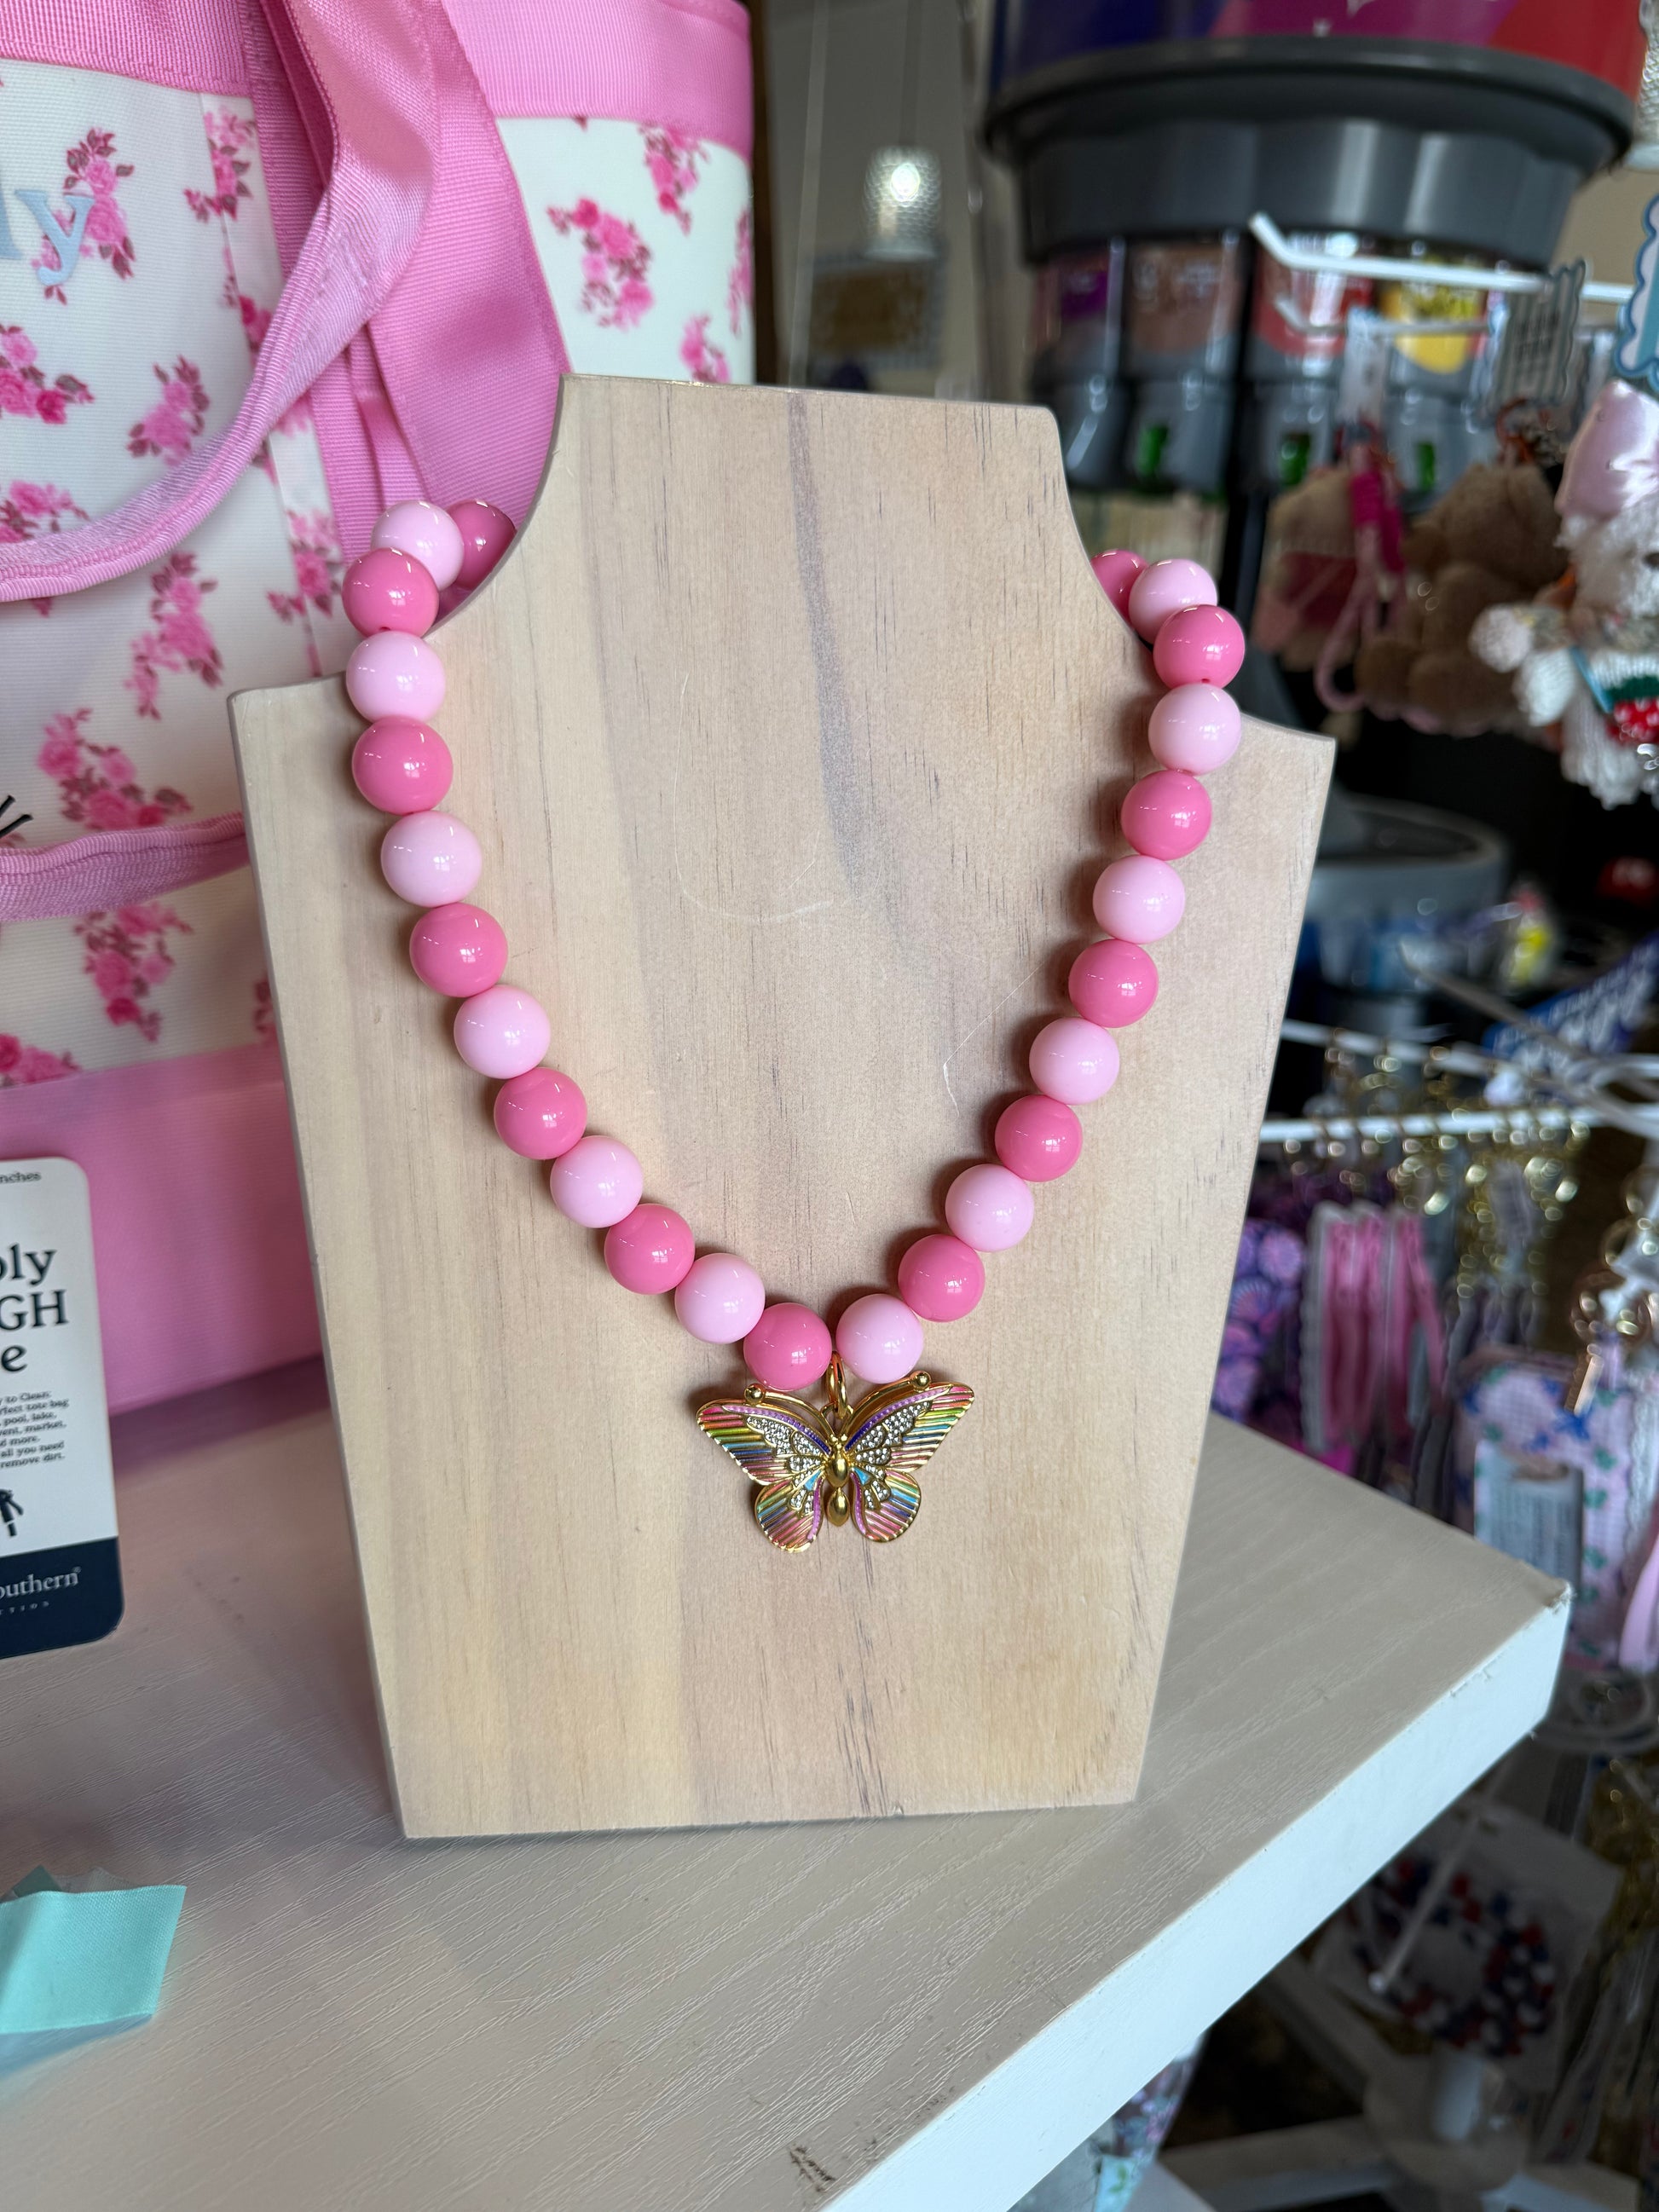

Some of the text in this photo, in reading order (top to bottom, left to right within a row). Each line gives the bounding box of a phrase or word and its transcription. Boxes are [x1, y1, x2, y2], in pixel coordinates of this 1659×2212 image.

[0, 1289, 69, 1331] GH
[1, 1344, 27, 1373] e
[17, 1446, 37, 1457] you
[39, 1440, 65, 1452] need
[0, 1456, 40, 1468] remove
